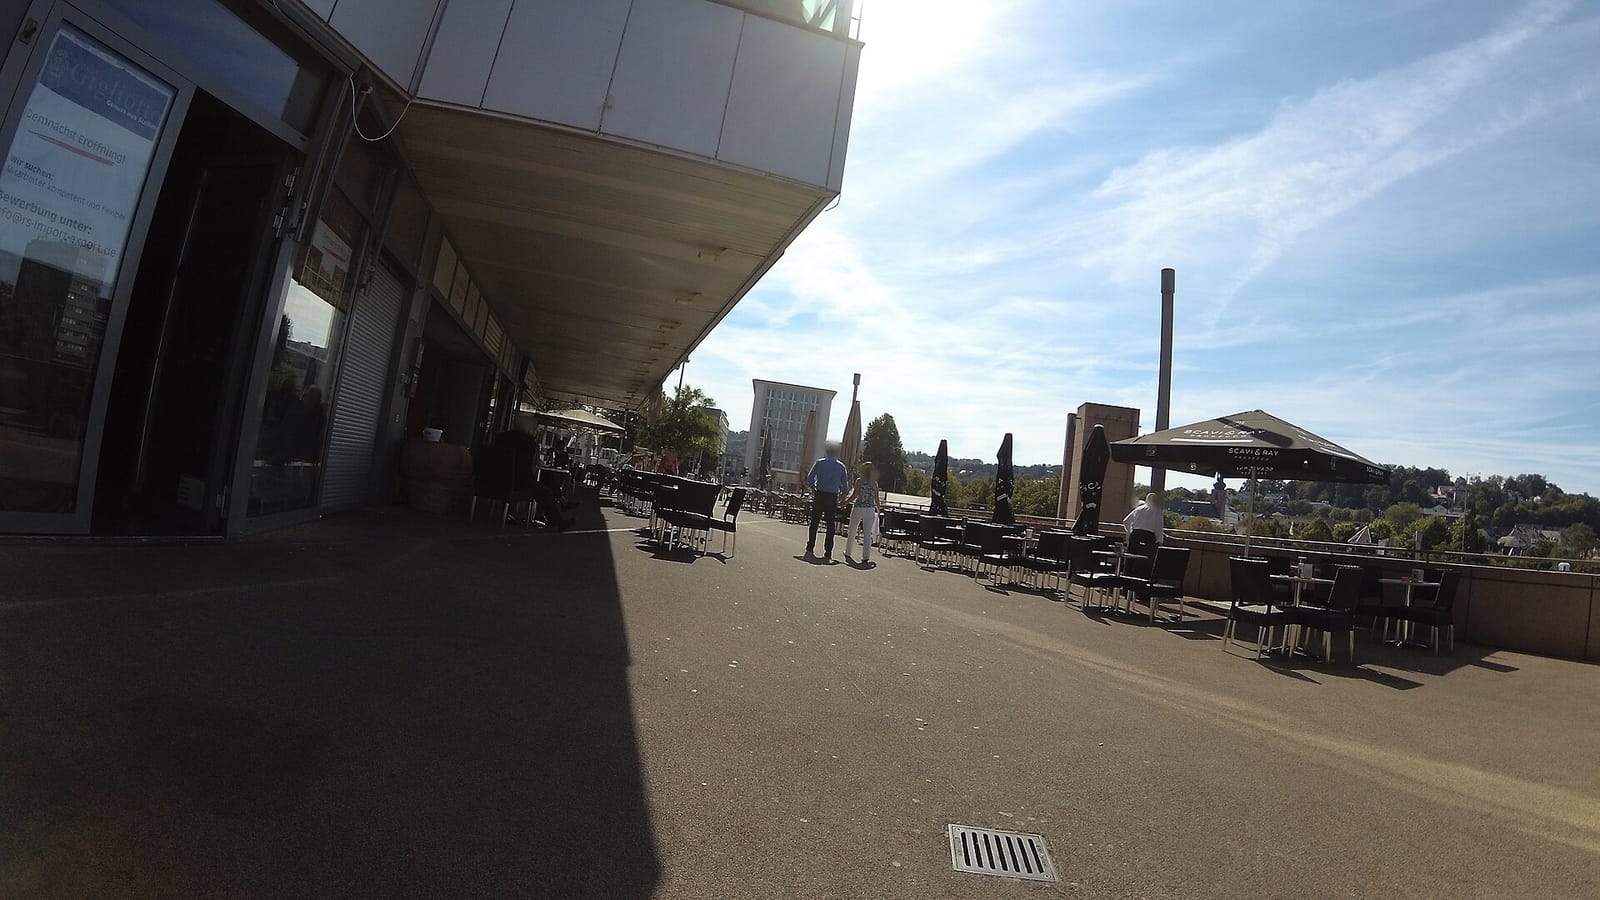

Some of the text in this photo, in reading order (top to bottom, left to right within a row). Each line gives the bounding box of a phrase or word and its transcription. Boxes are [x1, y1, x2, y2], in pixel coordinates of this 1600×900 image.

[59, 208, 92, 234] unter:
[1228, 447, 1254, 455] SCAVI
[1254, 448, 1261, 456] &
